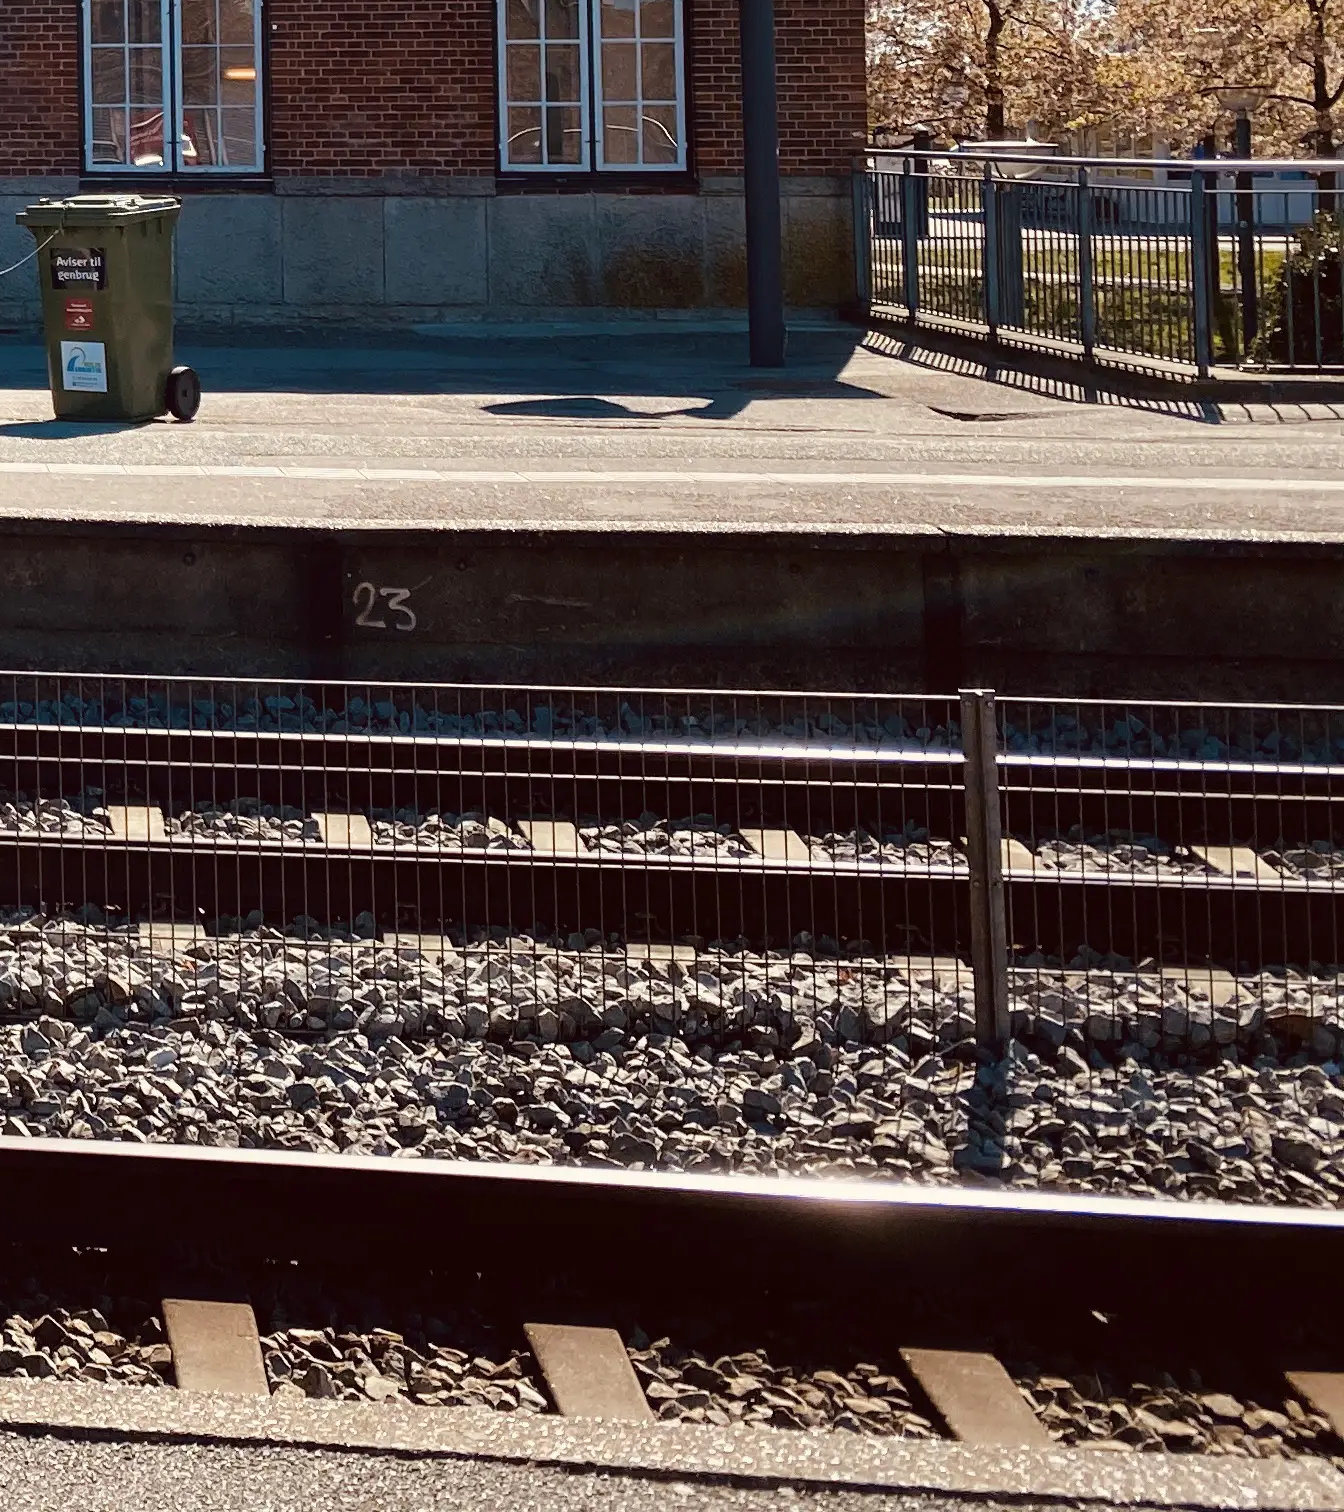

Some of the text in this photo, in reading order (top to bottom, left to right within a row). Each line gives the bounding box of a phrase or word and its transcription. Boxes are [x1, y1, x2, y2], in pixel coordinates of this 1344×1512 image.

[56, 256, 102, 267] Aviser til
[57, 269, 100, 282] genbrug
[353, 581, 417, 632] 23
